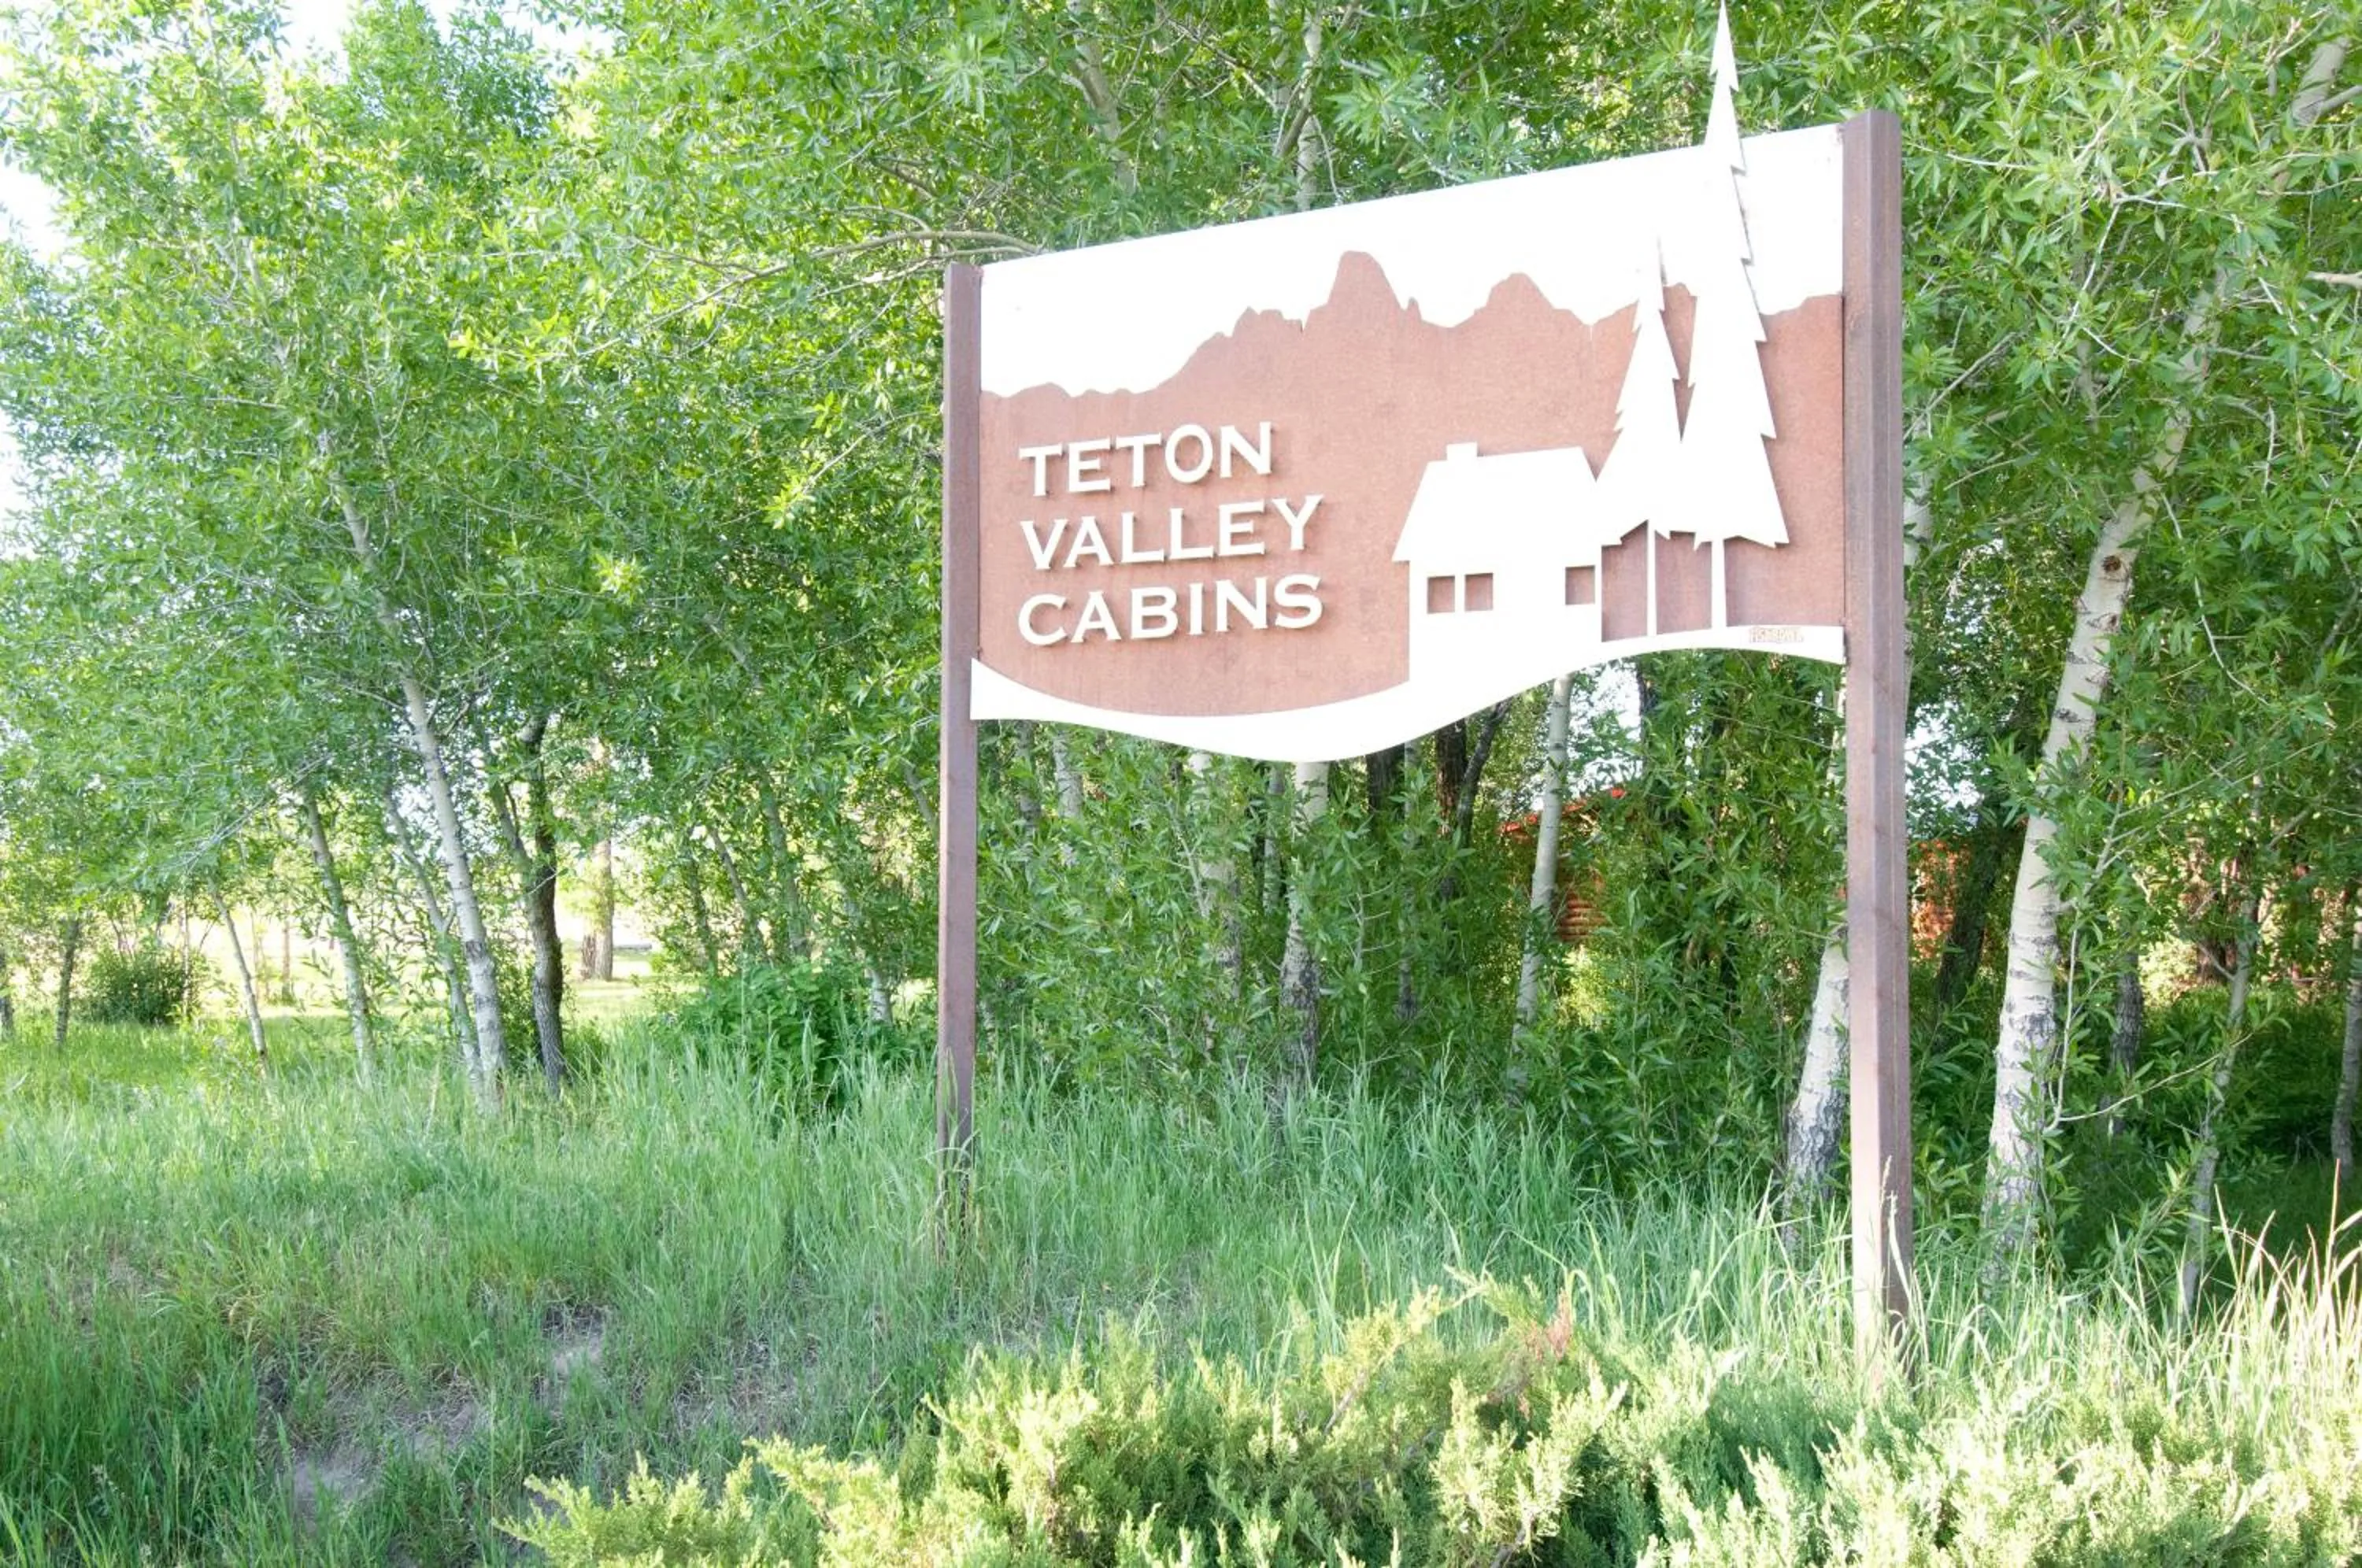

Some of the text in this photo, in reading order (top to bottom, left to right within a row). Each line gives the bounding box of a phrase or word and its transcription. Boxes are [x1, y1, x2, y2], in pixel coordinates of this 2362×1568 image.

[1019, 422, 1272, 497] TETON
[1020, 494, 1324, 570] VALLEY
[1018, 573, 1324, 646] CABINS
